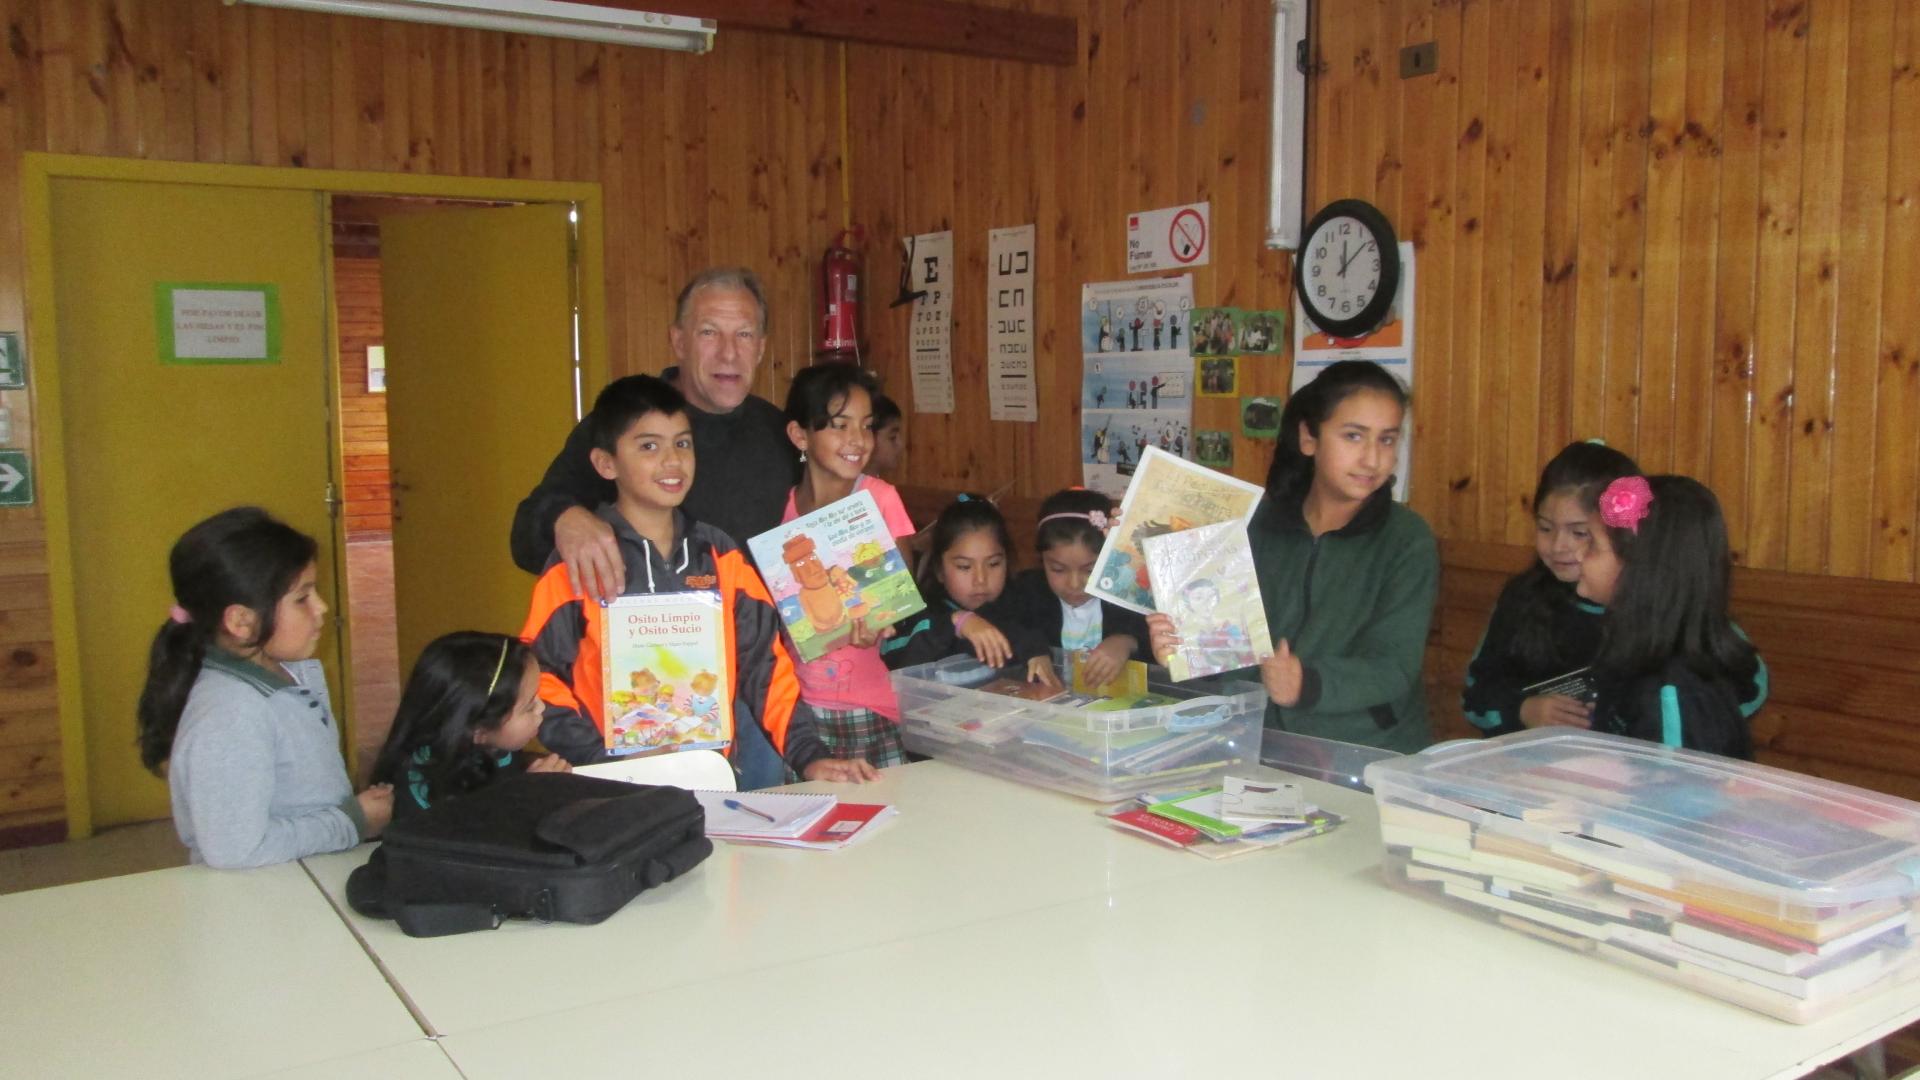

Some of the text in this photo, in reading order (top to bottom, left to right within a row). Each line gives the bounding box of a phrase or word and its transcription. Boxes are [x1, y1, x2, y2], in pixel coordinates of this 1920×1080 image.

[1338, 223, 1350, 235] 12
[1325, 231, 1334, 243] 11
[1129, 240, 1140, 249] No
[1368, 240, 1376, 252] 2
[1129, 251, 1152, 260] Fumar
[1315, 246, 1327, 259] 10
[924, 257, 938, 283] E
[1312, 265, 1321, 277] 9
[1372, 259, 1379, 272] 3
[1318, 285, 1326, 297] 8
[1368, 280, 1376, 292] 4
[1328, 297, 1336, 309] 7
[1341, 301, 1350, 313] 6
[1357, 295, 1365, 307] 5
[628, 612, 701, 625] Osito Limpio
[629, 623, 702, 639] y Osito Sucio
